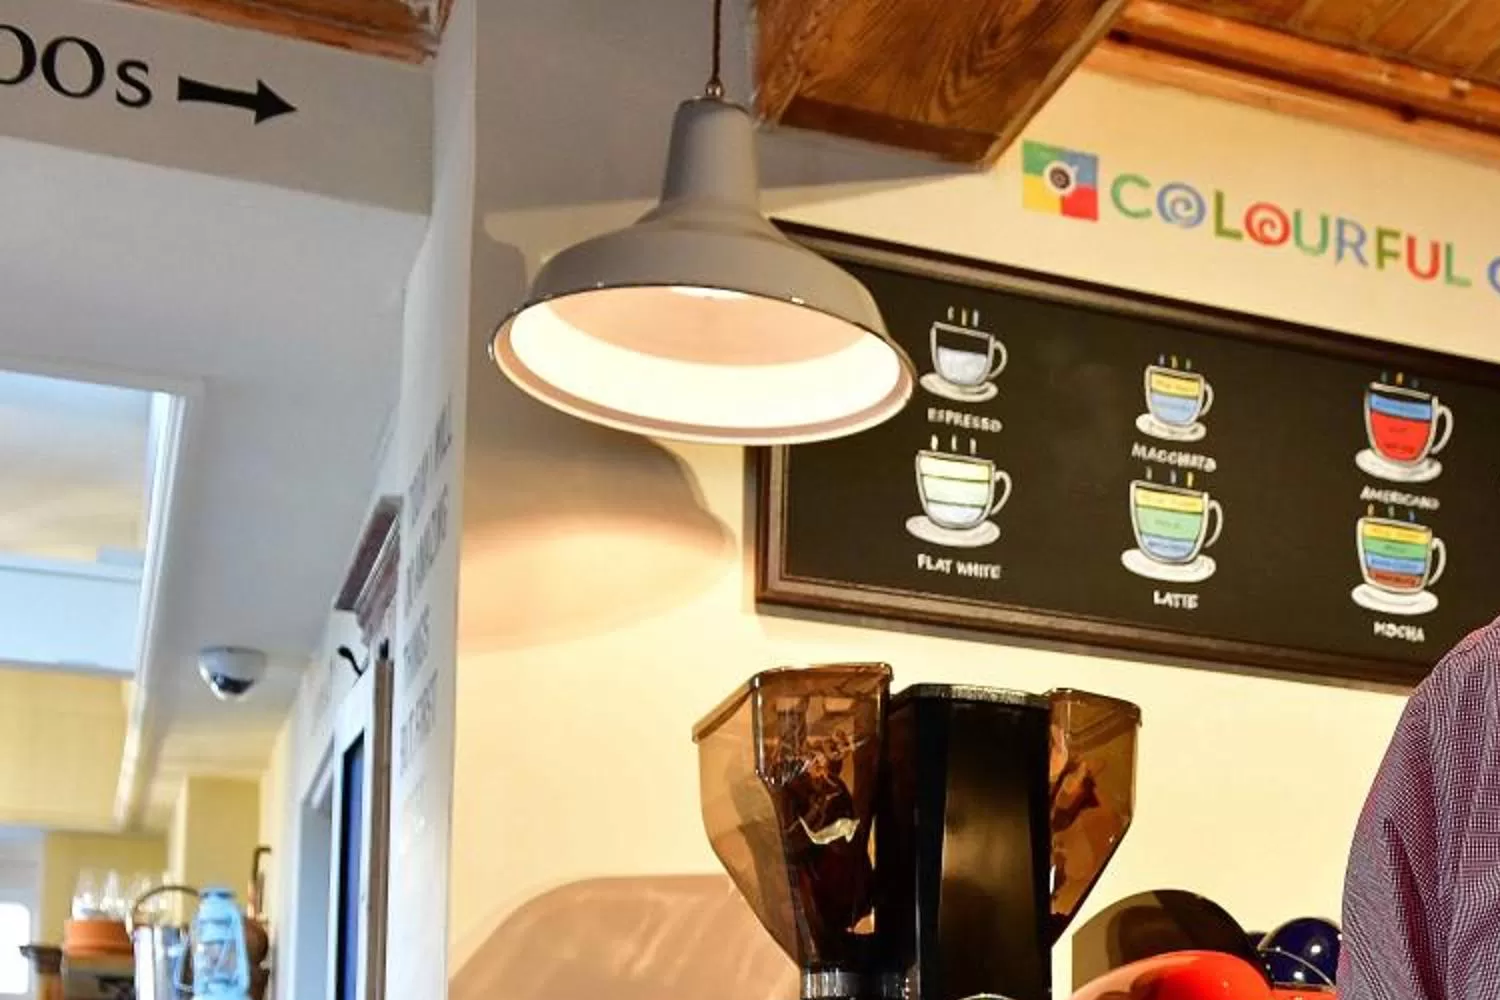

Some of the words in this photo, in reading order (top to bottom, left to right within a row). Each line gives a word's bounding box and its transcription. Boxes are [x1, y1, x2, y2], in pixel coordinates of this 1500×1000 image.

[1109, 172, 1472, 288] COLOURFUL
[927, 407, 1003, 433] ESPRESSO
[917, 553, 953, 574] FLAT
[956, 561, 1002, 579] WHITE
[1153, 590, 1199, 609] LATTE
[1373, 621, 1425, 642] MOCHA
